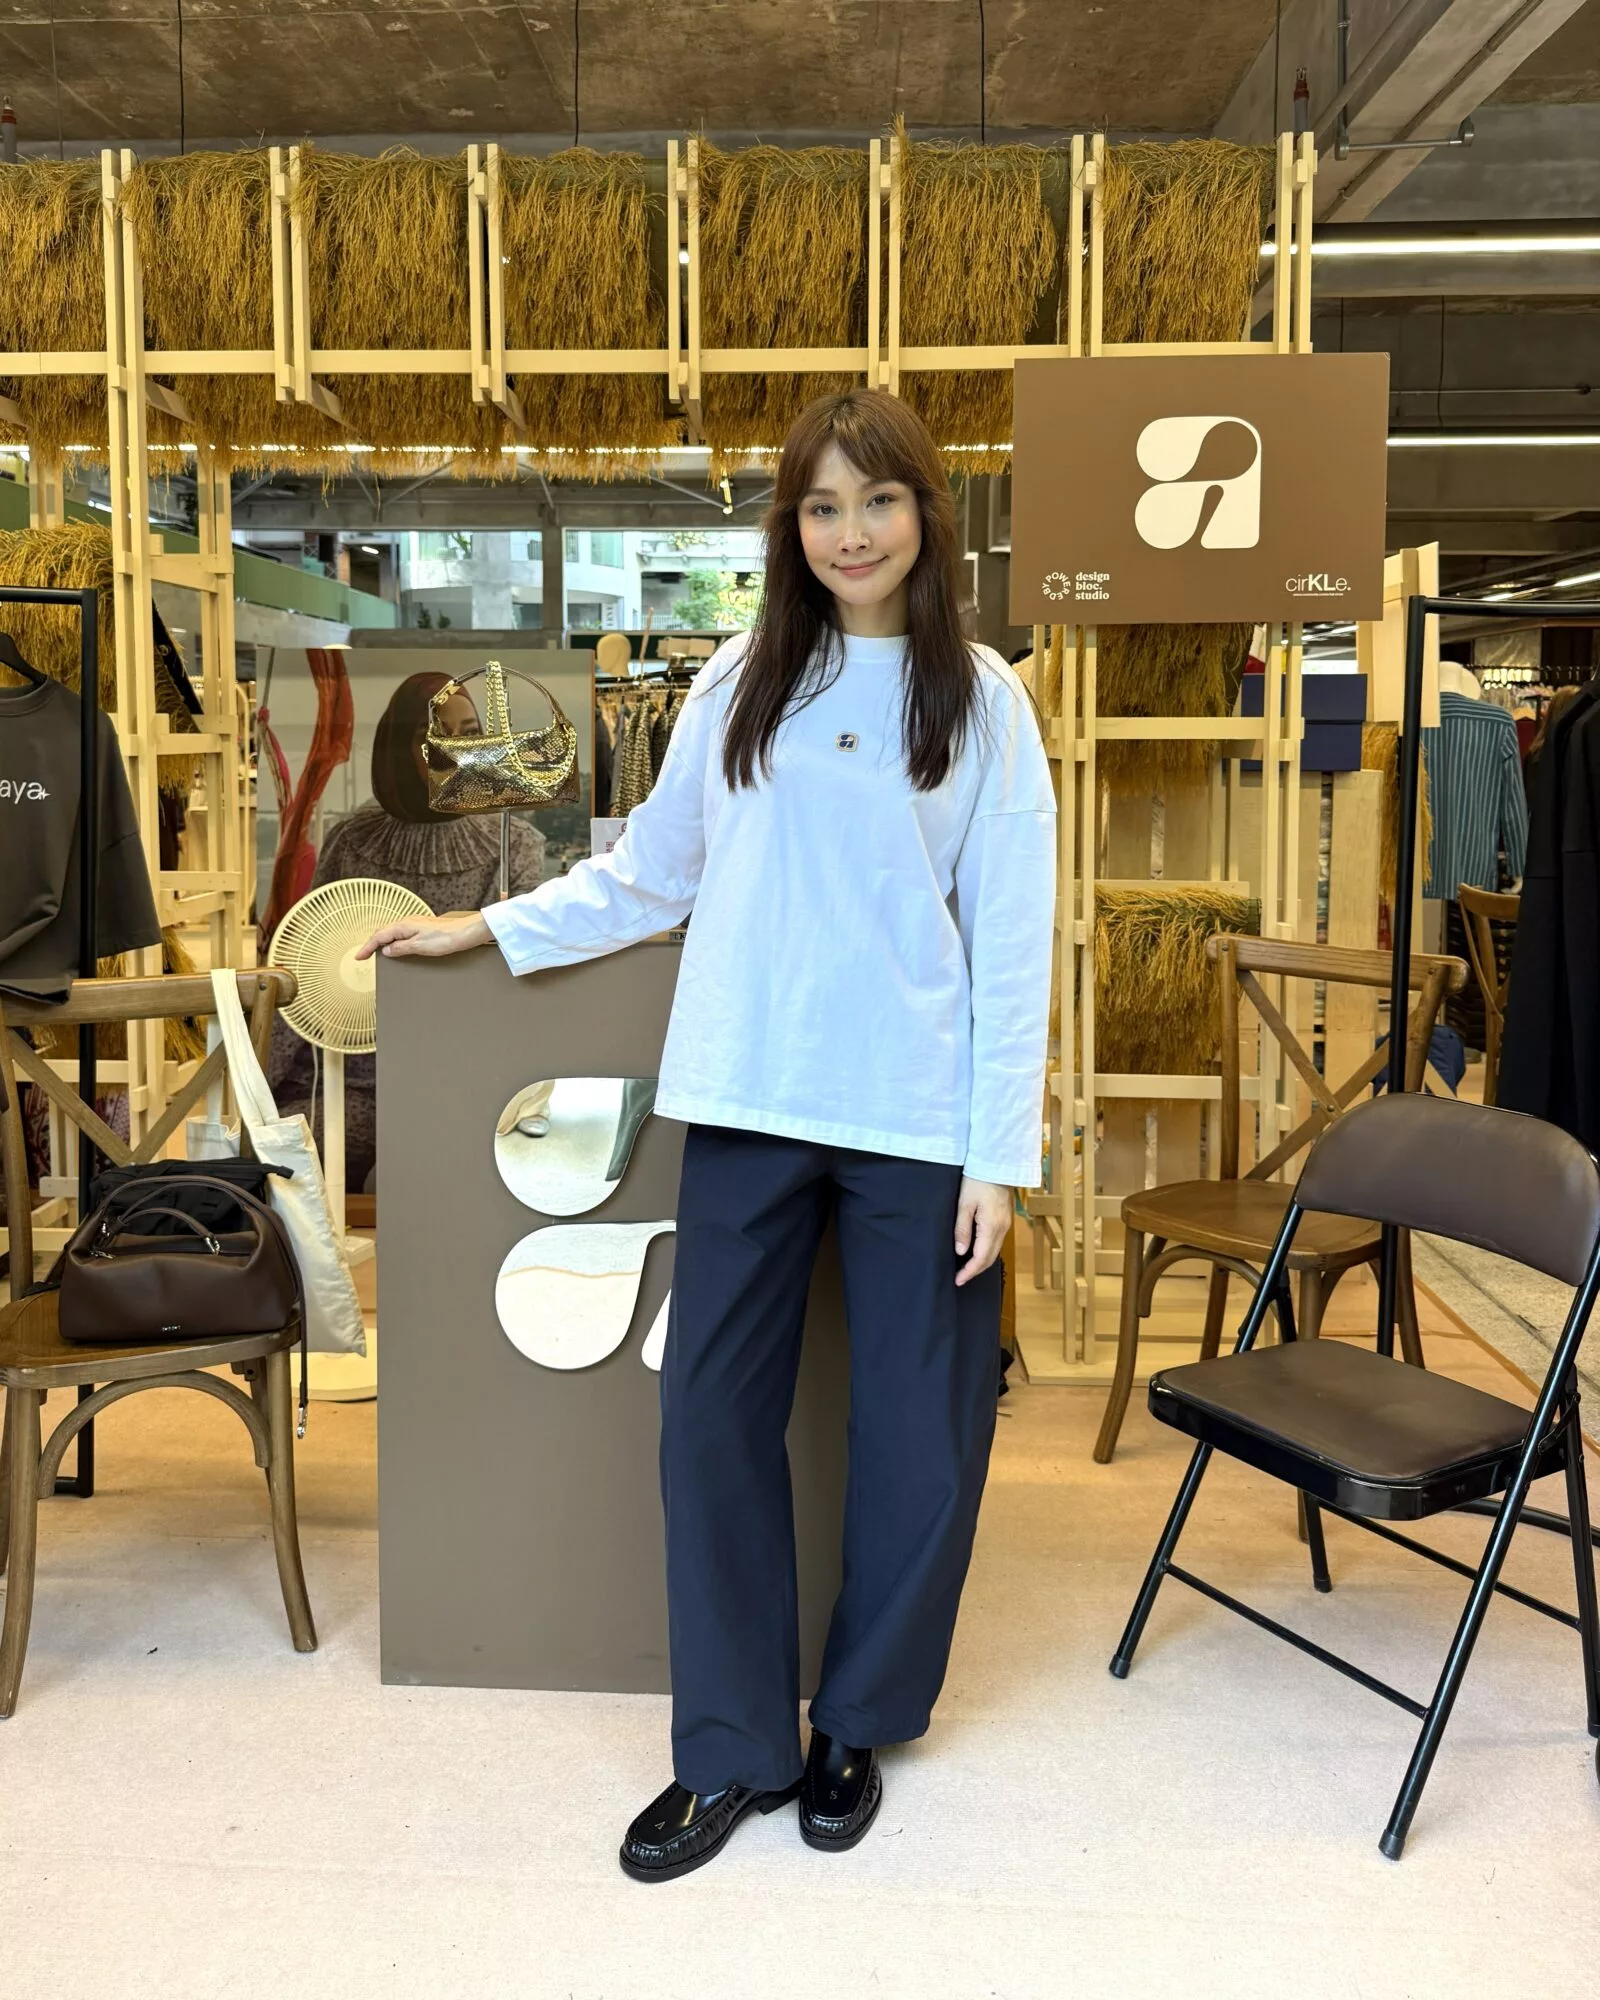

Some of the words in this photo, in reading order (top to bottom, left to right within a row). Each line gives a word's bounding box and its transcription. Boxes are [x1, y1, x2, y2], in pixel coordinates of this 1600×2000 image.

[1075, 571, 1110, 583] design
[1285, 573, 1352, 592] cirKLe.
[1045, 571, 1071, 600] POWERED
[1075, 581, 1103, 591] bloc.
[1075, 590, 1110, 600] studio
